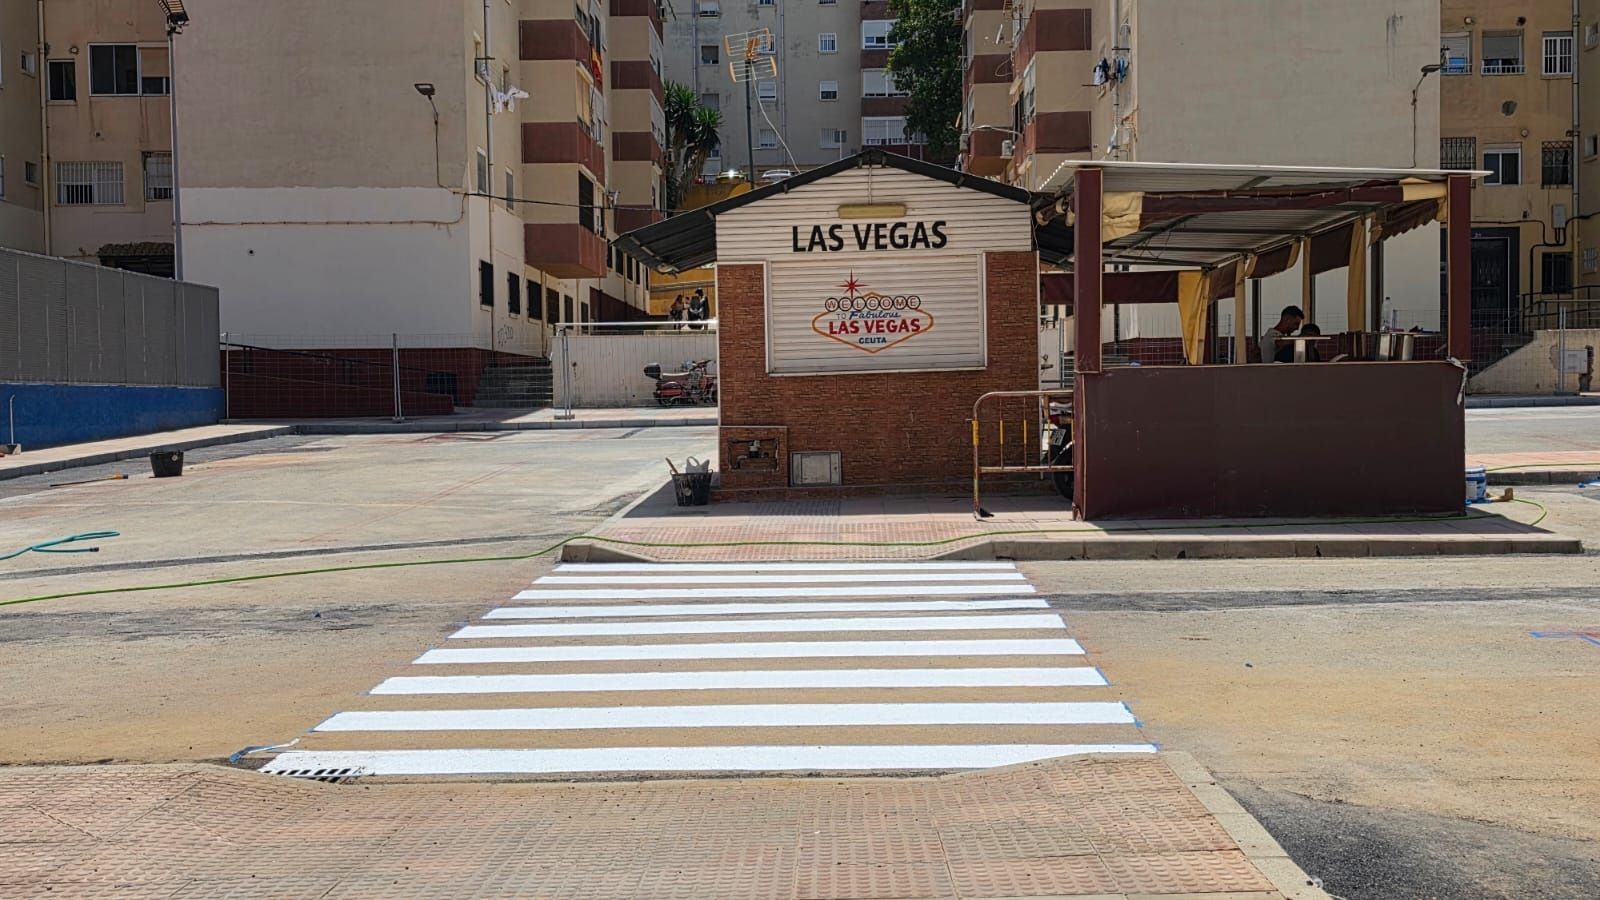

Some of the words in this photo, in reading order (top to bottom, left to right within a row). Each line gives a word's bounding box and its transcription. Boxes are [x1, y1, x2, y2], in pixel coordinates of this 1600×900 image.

[792, 224, 844, 252] LAS
[852, 220, 948, 250] VEGAS
[826, 296, 920, 311] WELCOME
[849, 311, 901, 320] Fabulous
[829, 320, 860, 334] LAS
[864, 318, 921, 334] VEGAS
